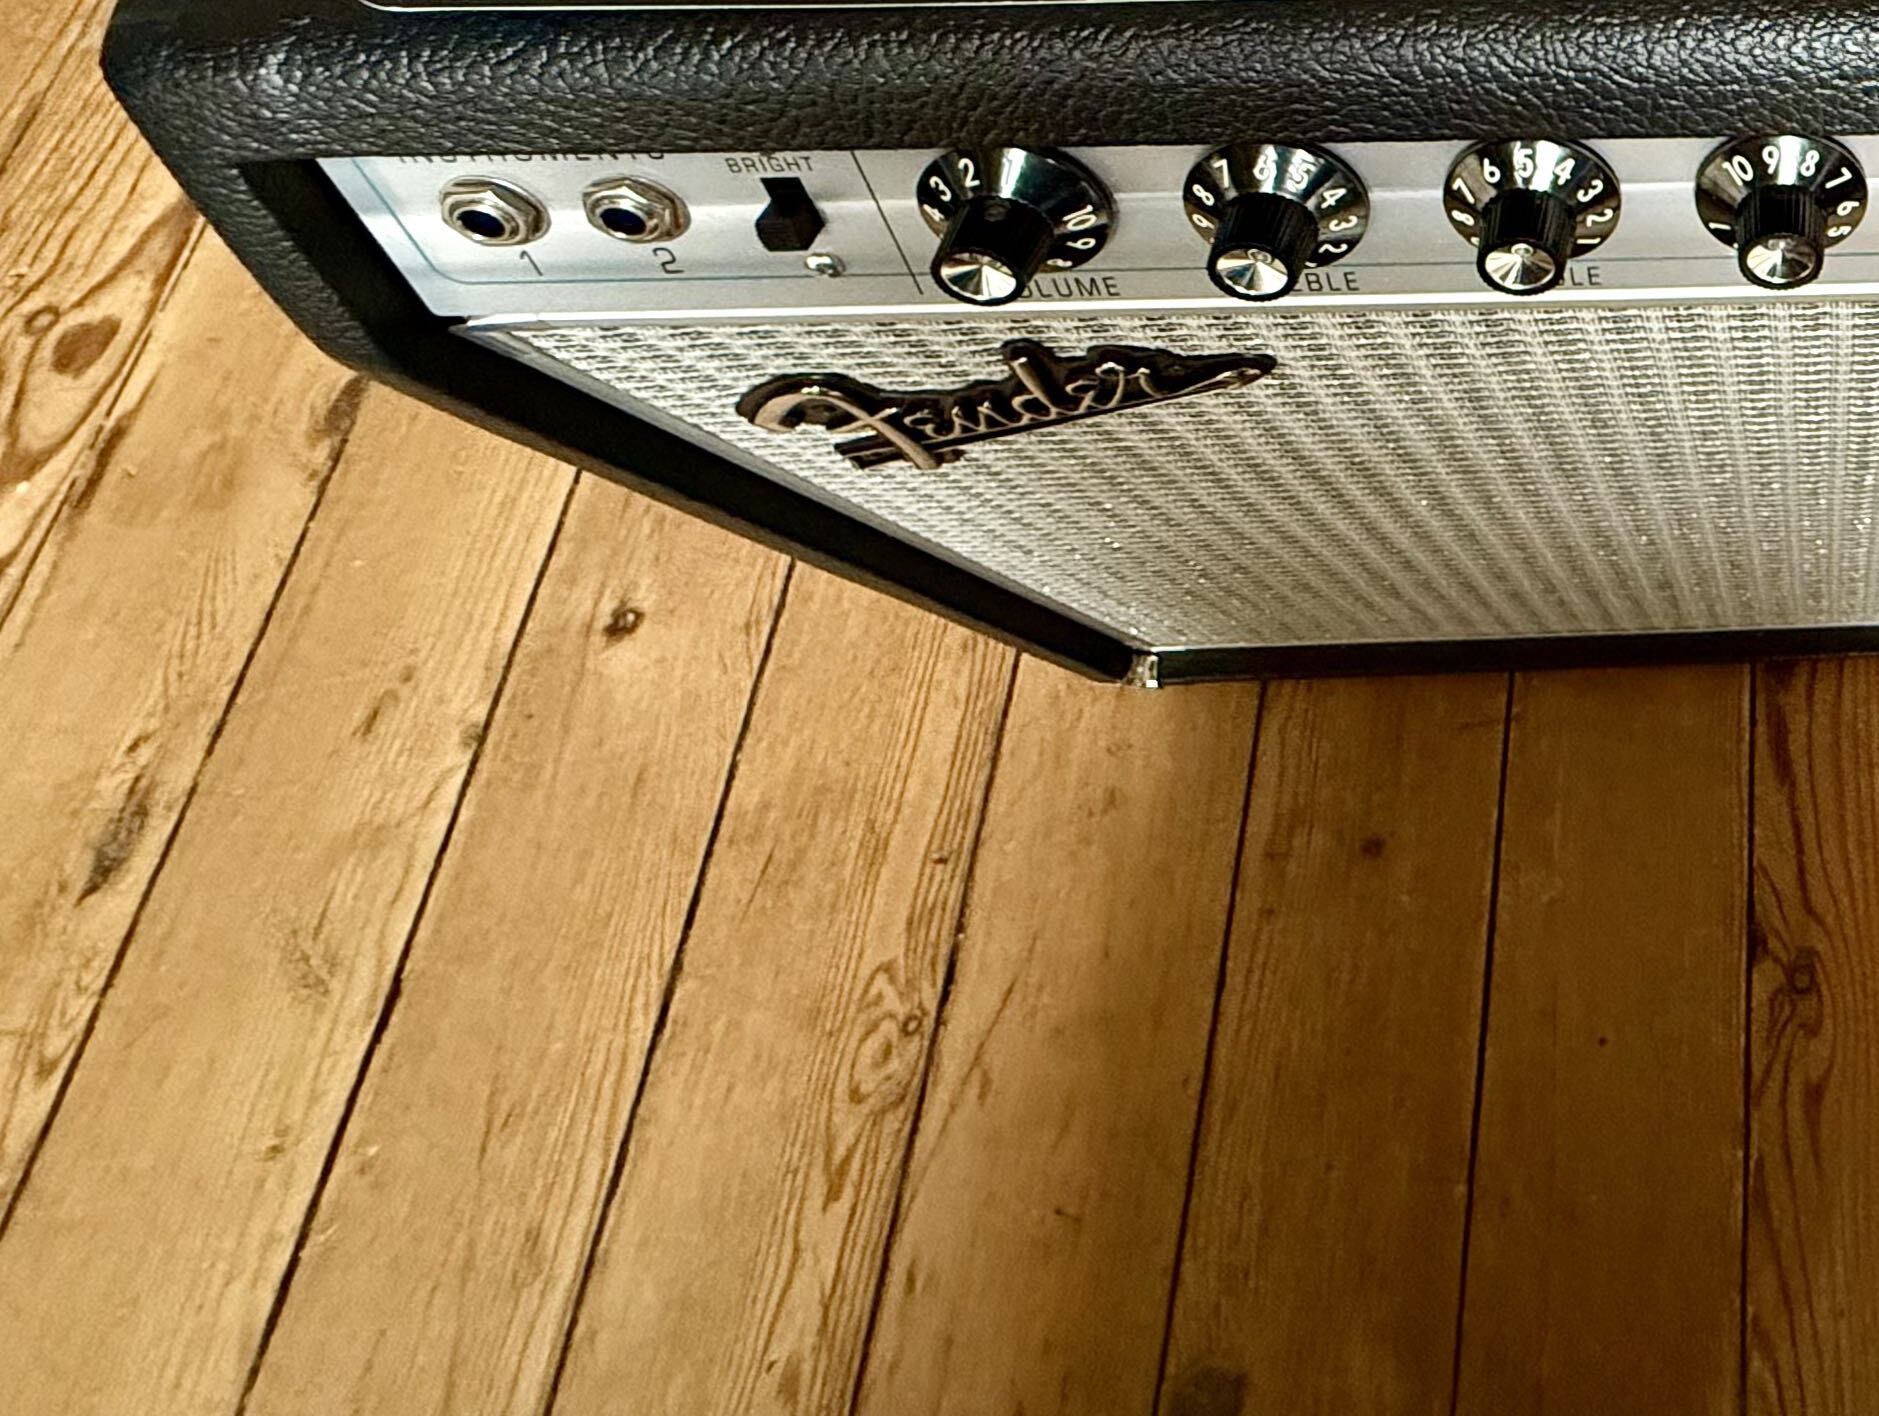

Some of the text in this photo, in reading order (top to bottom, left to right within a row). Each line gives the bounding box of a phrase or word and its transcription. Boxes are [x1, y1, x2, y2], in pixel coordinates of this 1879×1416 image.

[725, 156, 813, 173] BRIGHT
[519, 250, 545, 277] 1
[652, 247, 685, 275] 2
[738, 339, 1277, 470] Fender
